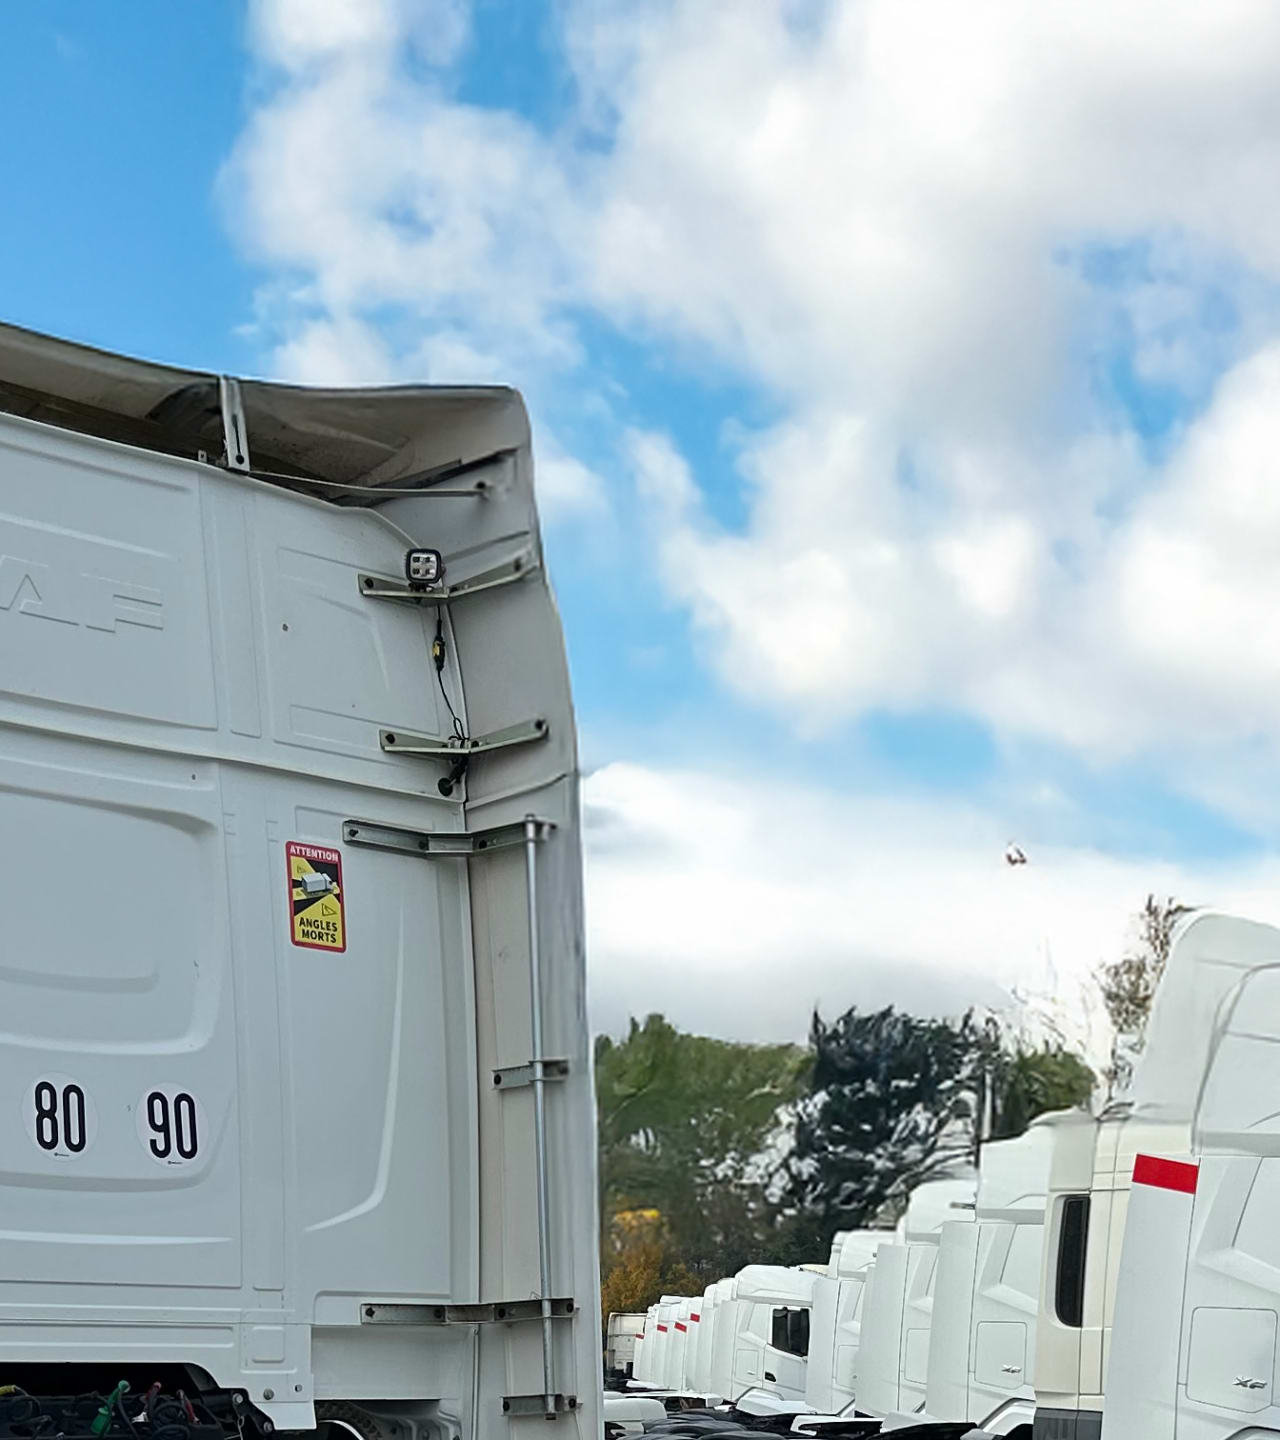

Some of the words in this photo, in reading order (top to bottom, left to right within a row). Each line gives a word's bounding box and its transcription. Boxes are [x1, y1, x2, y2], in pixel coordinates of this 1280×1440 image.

[290, 845, 339, 862] ATTENTION
[299, 917, 338, 932] ANGLES
[302, 929, 337, 943] MORTS
[34, 1080, 87, 1153] 80
[147, 1091, 198, 1160] 90
